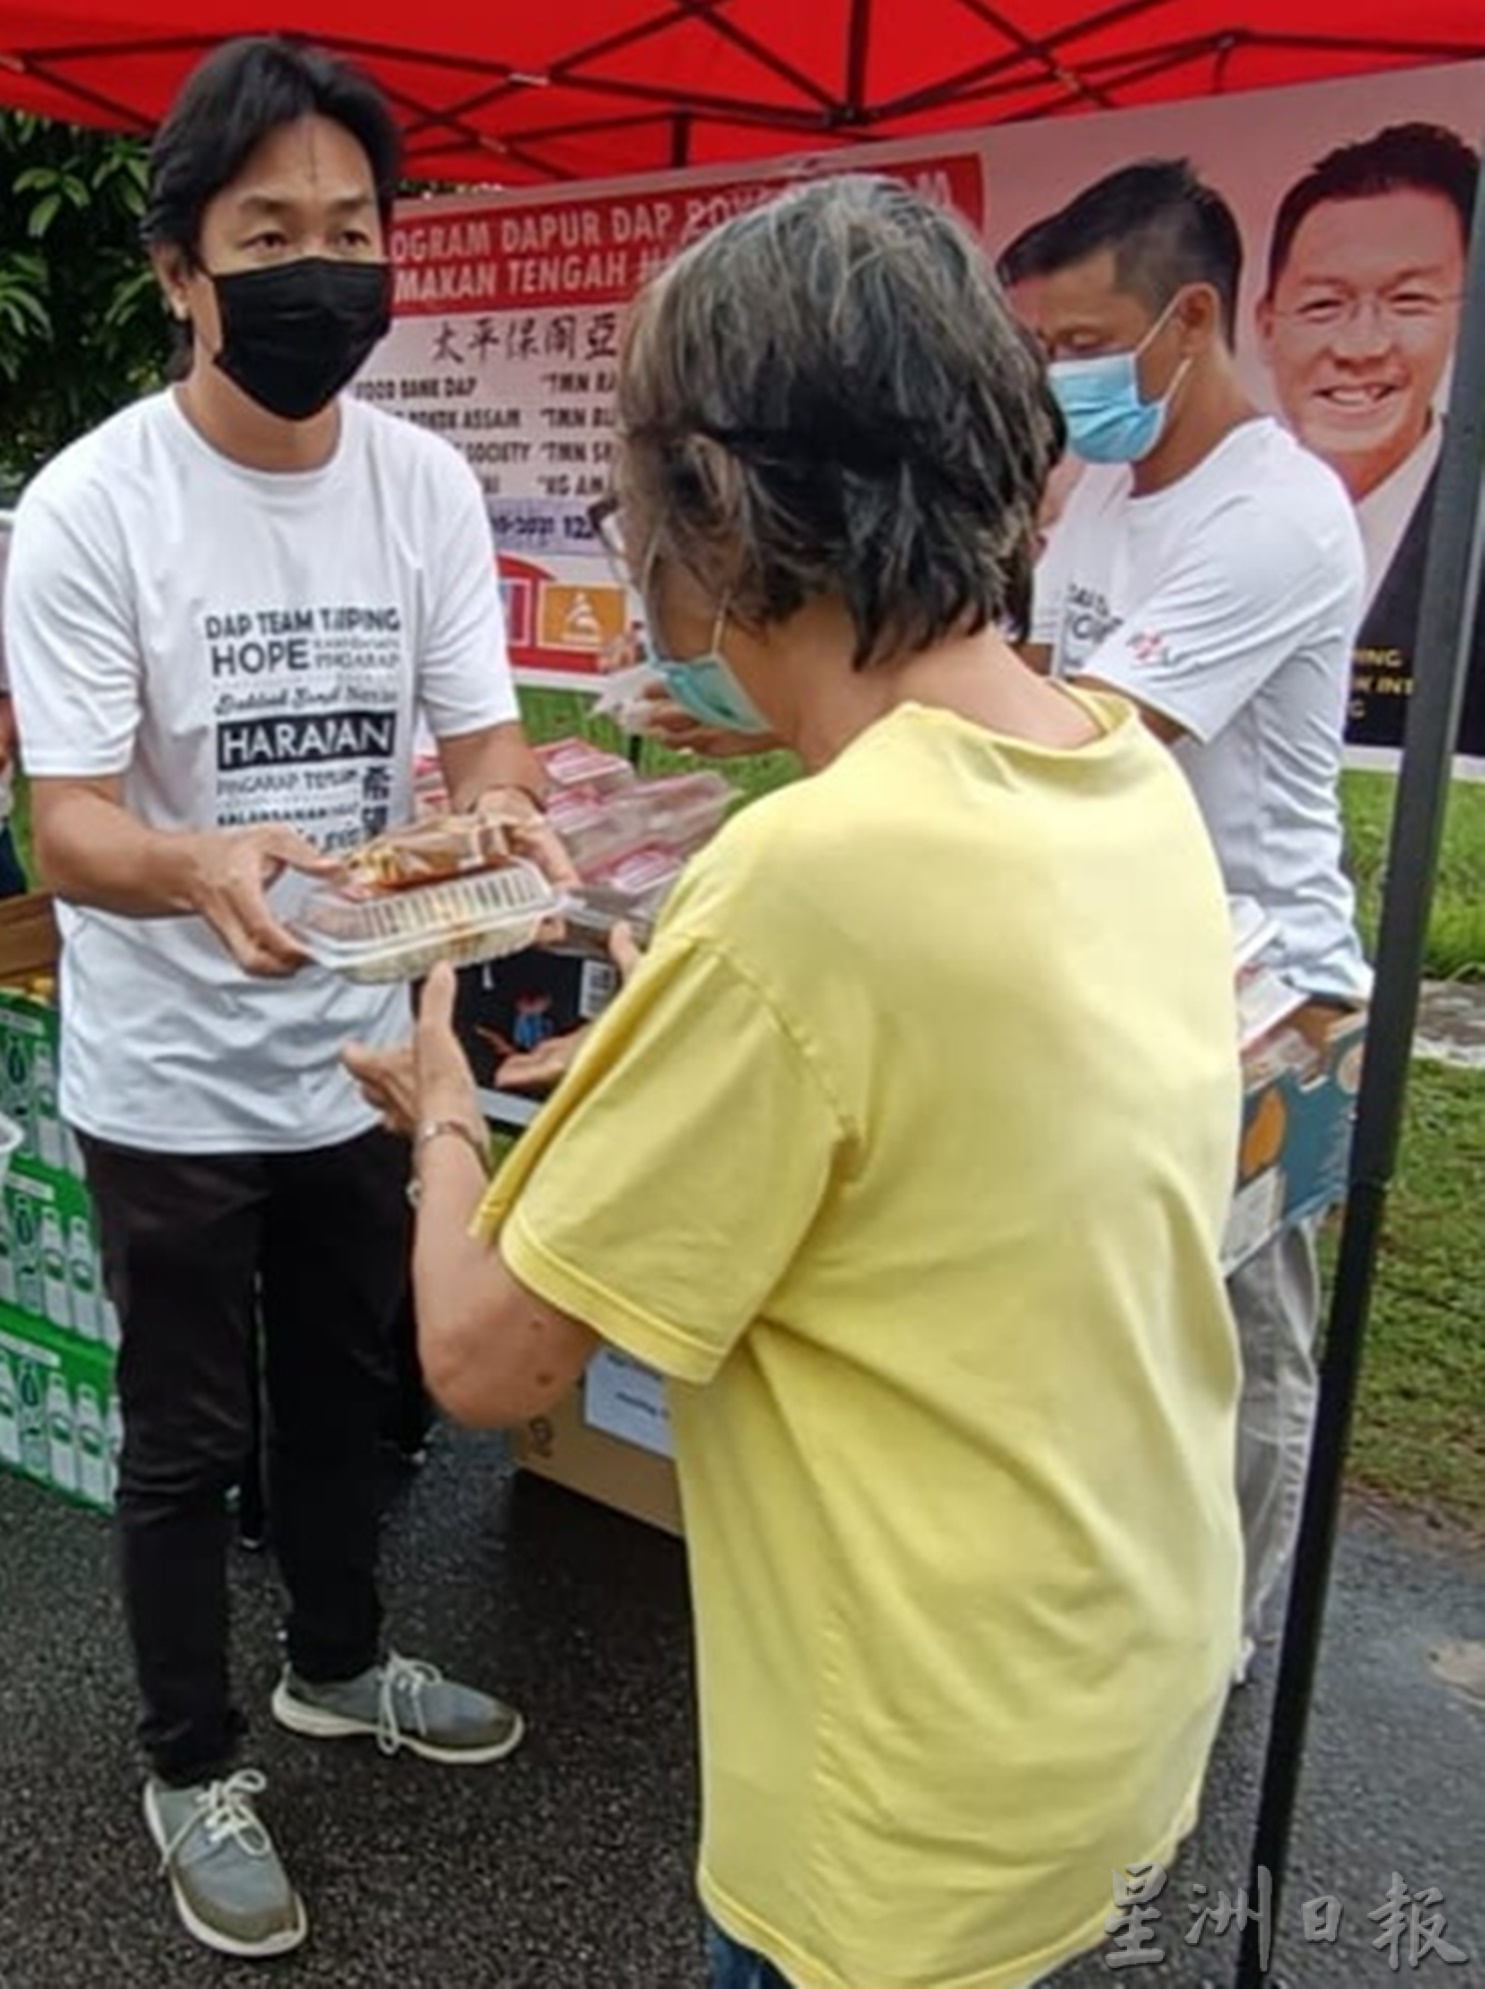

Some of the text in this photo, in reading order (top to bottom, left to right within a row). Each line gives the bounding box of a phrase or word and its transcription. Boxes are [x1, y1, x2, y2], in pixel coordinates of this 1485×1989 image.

[502, 209, 601, 252] DAPUR
[611, 200, 672, 243] DAP
[394, 263, 498, 303] MAKAN
[508, 249, 627, 294] TENGAH
[205, 615, 252, 640] DAP
[257, 610, 314, 636] TEAM
[211, 639, 310, 677] HOPE
